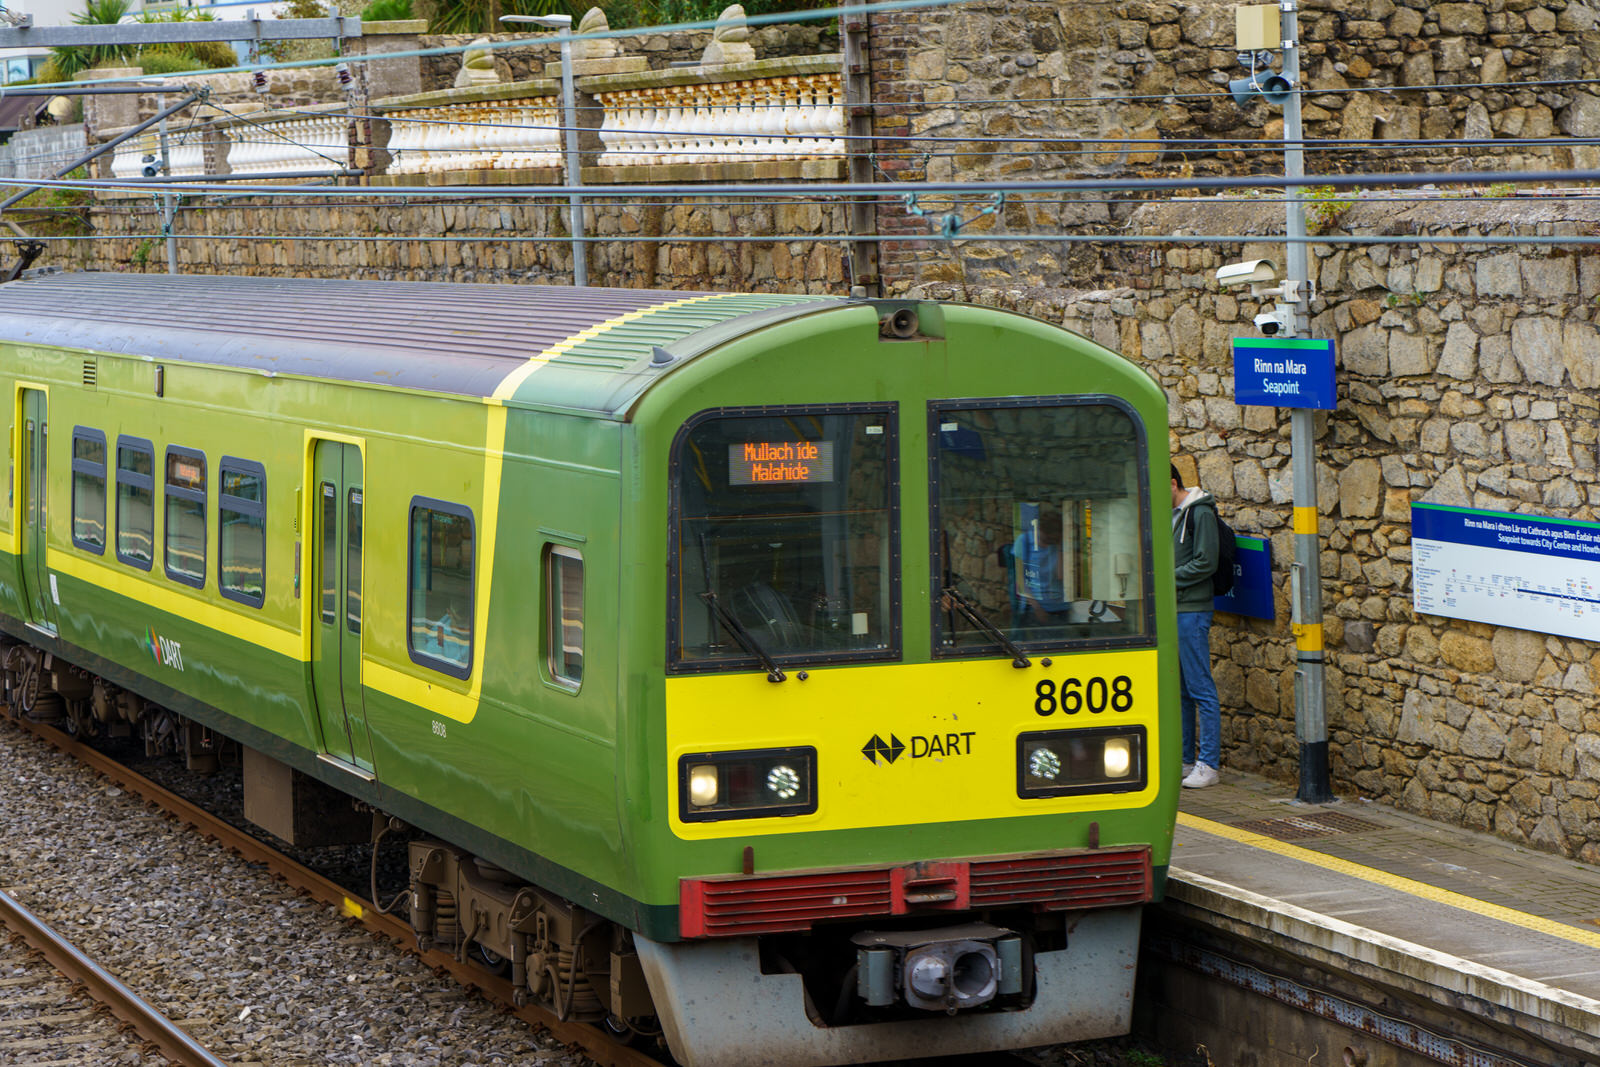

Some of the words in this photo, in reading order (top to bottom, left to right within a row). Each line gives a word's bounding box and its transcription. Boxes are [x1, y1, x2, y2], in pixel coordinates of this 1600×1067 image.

[1254, 358, 1273, 373] Rinn
[1274, 362, 1285, 374] na
[1285, 359, 1307, 375] Mara
[1263, 378, 1300, 397] Seapoint
[744, 442, 793, 461] Mullach
[752, 461, 809, 482] Malahide
[1464, 518, 1475, 528] Rinn
[1482, 520, 1495, 530] Mara
[1498, 533, 1520, 544] Seapoint
[1520, 536, 1541, 547] towards
[1541, 538, 1552, 550] City
[1553, 540, 1571, 551] Centre
[1571, 543, 1581, 552] and
[159, 635, 184, 672] DART
[1034, 675, 1134, 717] 8608
[432, 720, 447, 738] 8608
[911, 732, 976, 759] DART
